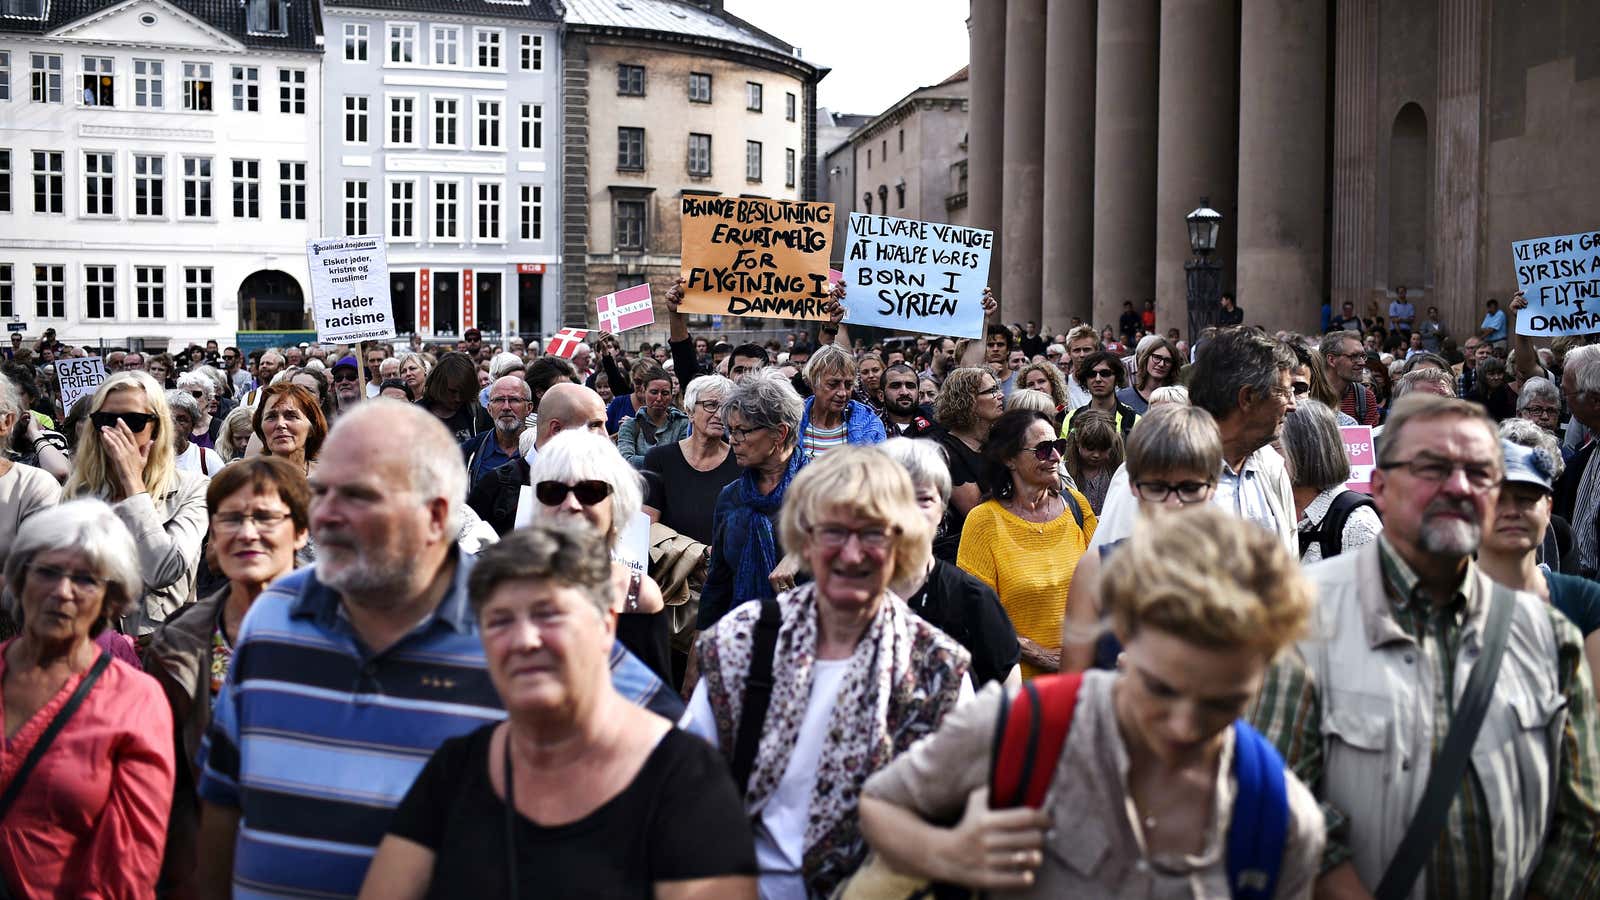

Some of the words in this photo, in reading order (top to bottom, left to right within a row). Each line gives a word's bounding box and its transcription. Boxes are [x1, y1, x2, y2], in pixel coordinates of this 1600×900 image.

[737, 200, 832, 224] BESLUTNING
[850, 239, 872, 260] AT
[876, 242, 929, 264] HJÆLPE
[1515, 243, 1531, 261] VI
[1533, 242, 1551, 260] ER
[1554, 239, 1573, 255] EN
[323, 257, 348, 266] Elsker
[328, 266, 357, 275] kristne
[358, 265, 369, 273] og
[732, 250, 778, 271] FOR
[331, 274, 368, 283] muslimer
[858, 267, 925, 287] BØRN
[941, 271, 962, 293] I
[1519, 258, 1586, 285] SYRISK
[688, 267, 805, 295] FLYGTNING
[808, 273, 829, 298] I
[332, 296, 374, 310] Hader
[728, 296, 829, 319] DANMARK
[878, 289, 958, 319] SYRIEN
[1572, 299, 1588, 316] I
[325, 312, 385, 328] racisme
[325, 329, 389, 342] www.socialister.dk
[59, 359, 101, 377] GÆST
[60, 374, 105, 389] FRIHED
